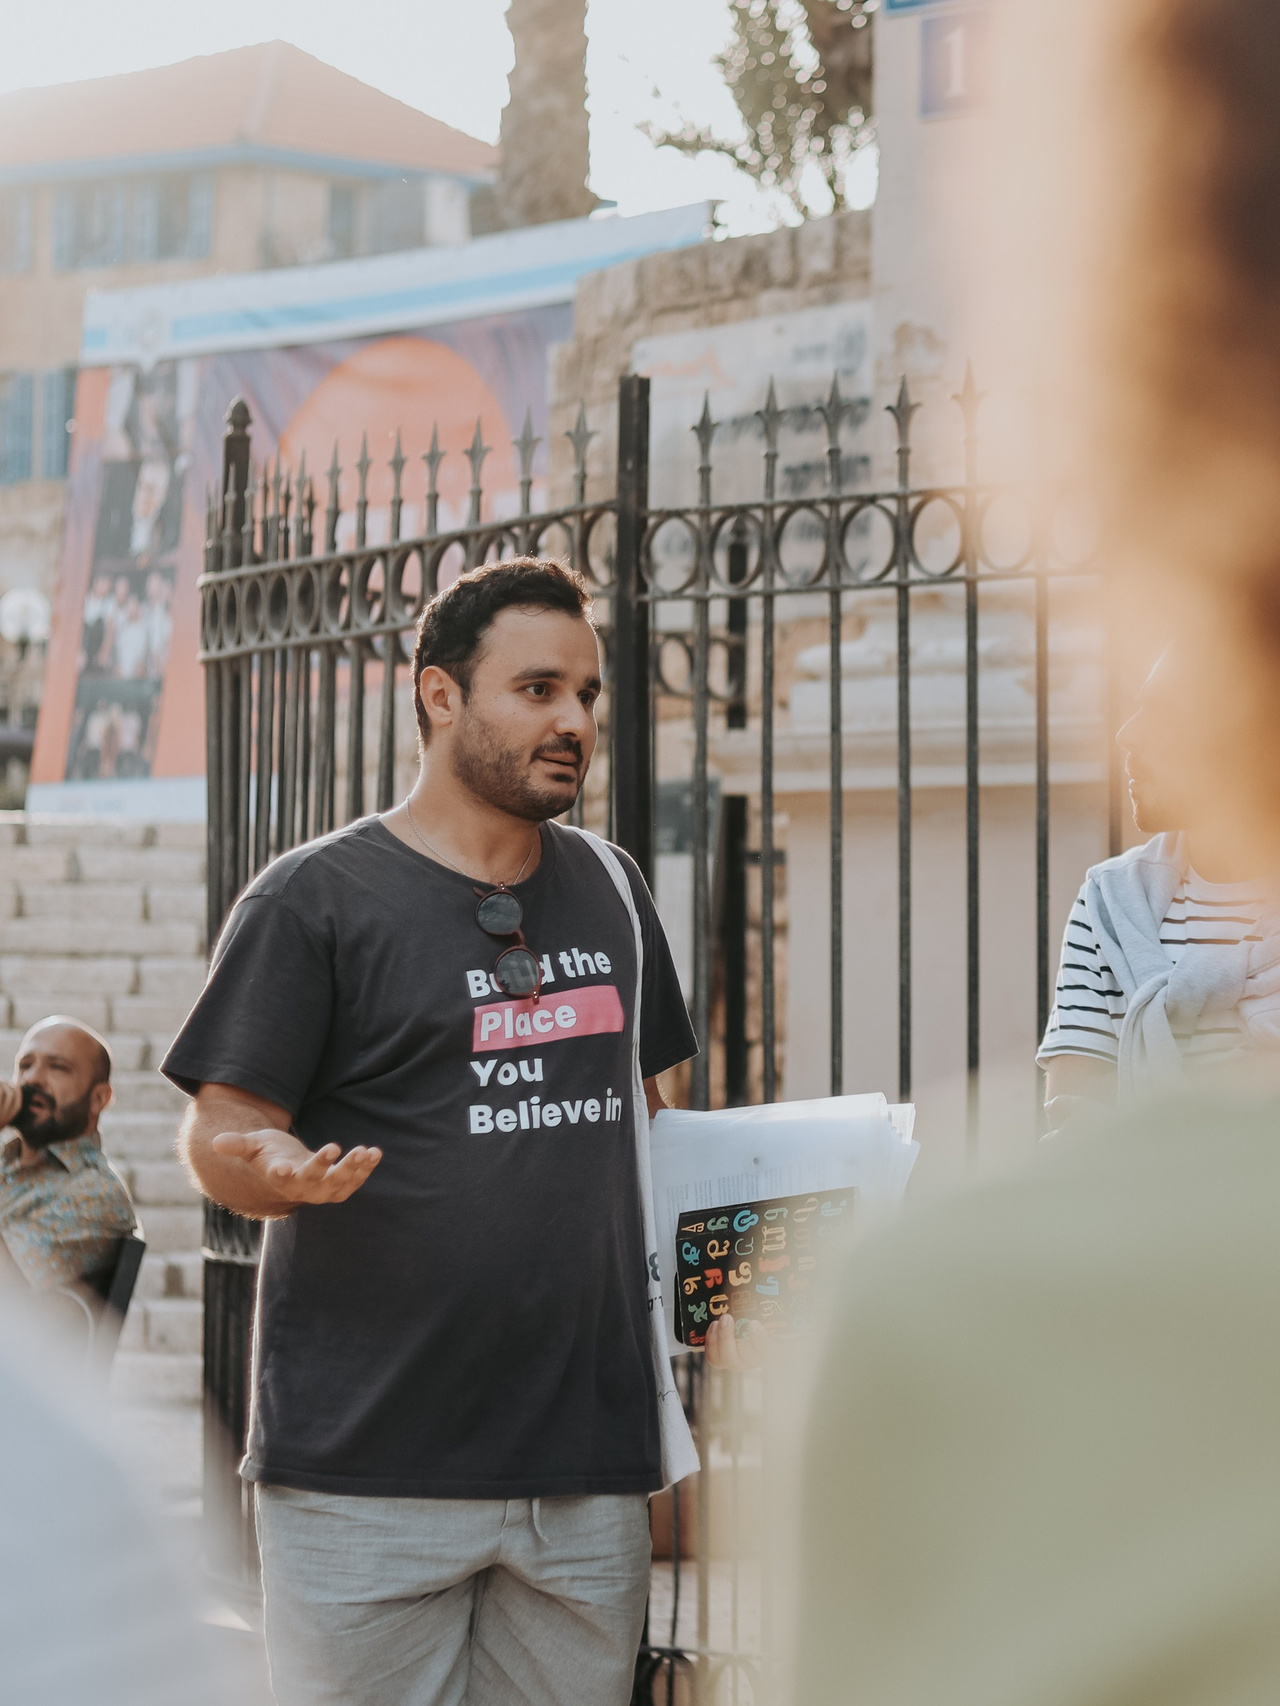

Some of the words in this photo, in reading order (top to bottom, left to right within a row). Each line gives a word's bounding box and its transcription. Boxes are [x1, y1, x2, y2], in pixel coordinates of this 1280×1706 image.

[945, 27, 968, 98] 1
[559, 947, 612, 978] the
[480, 1005, 577, 1041] Place
[470, 1058, 544, 1087] You
[469, 1096, 601, 1134] Believe
[605, 1087, 622, 1121] in
